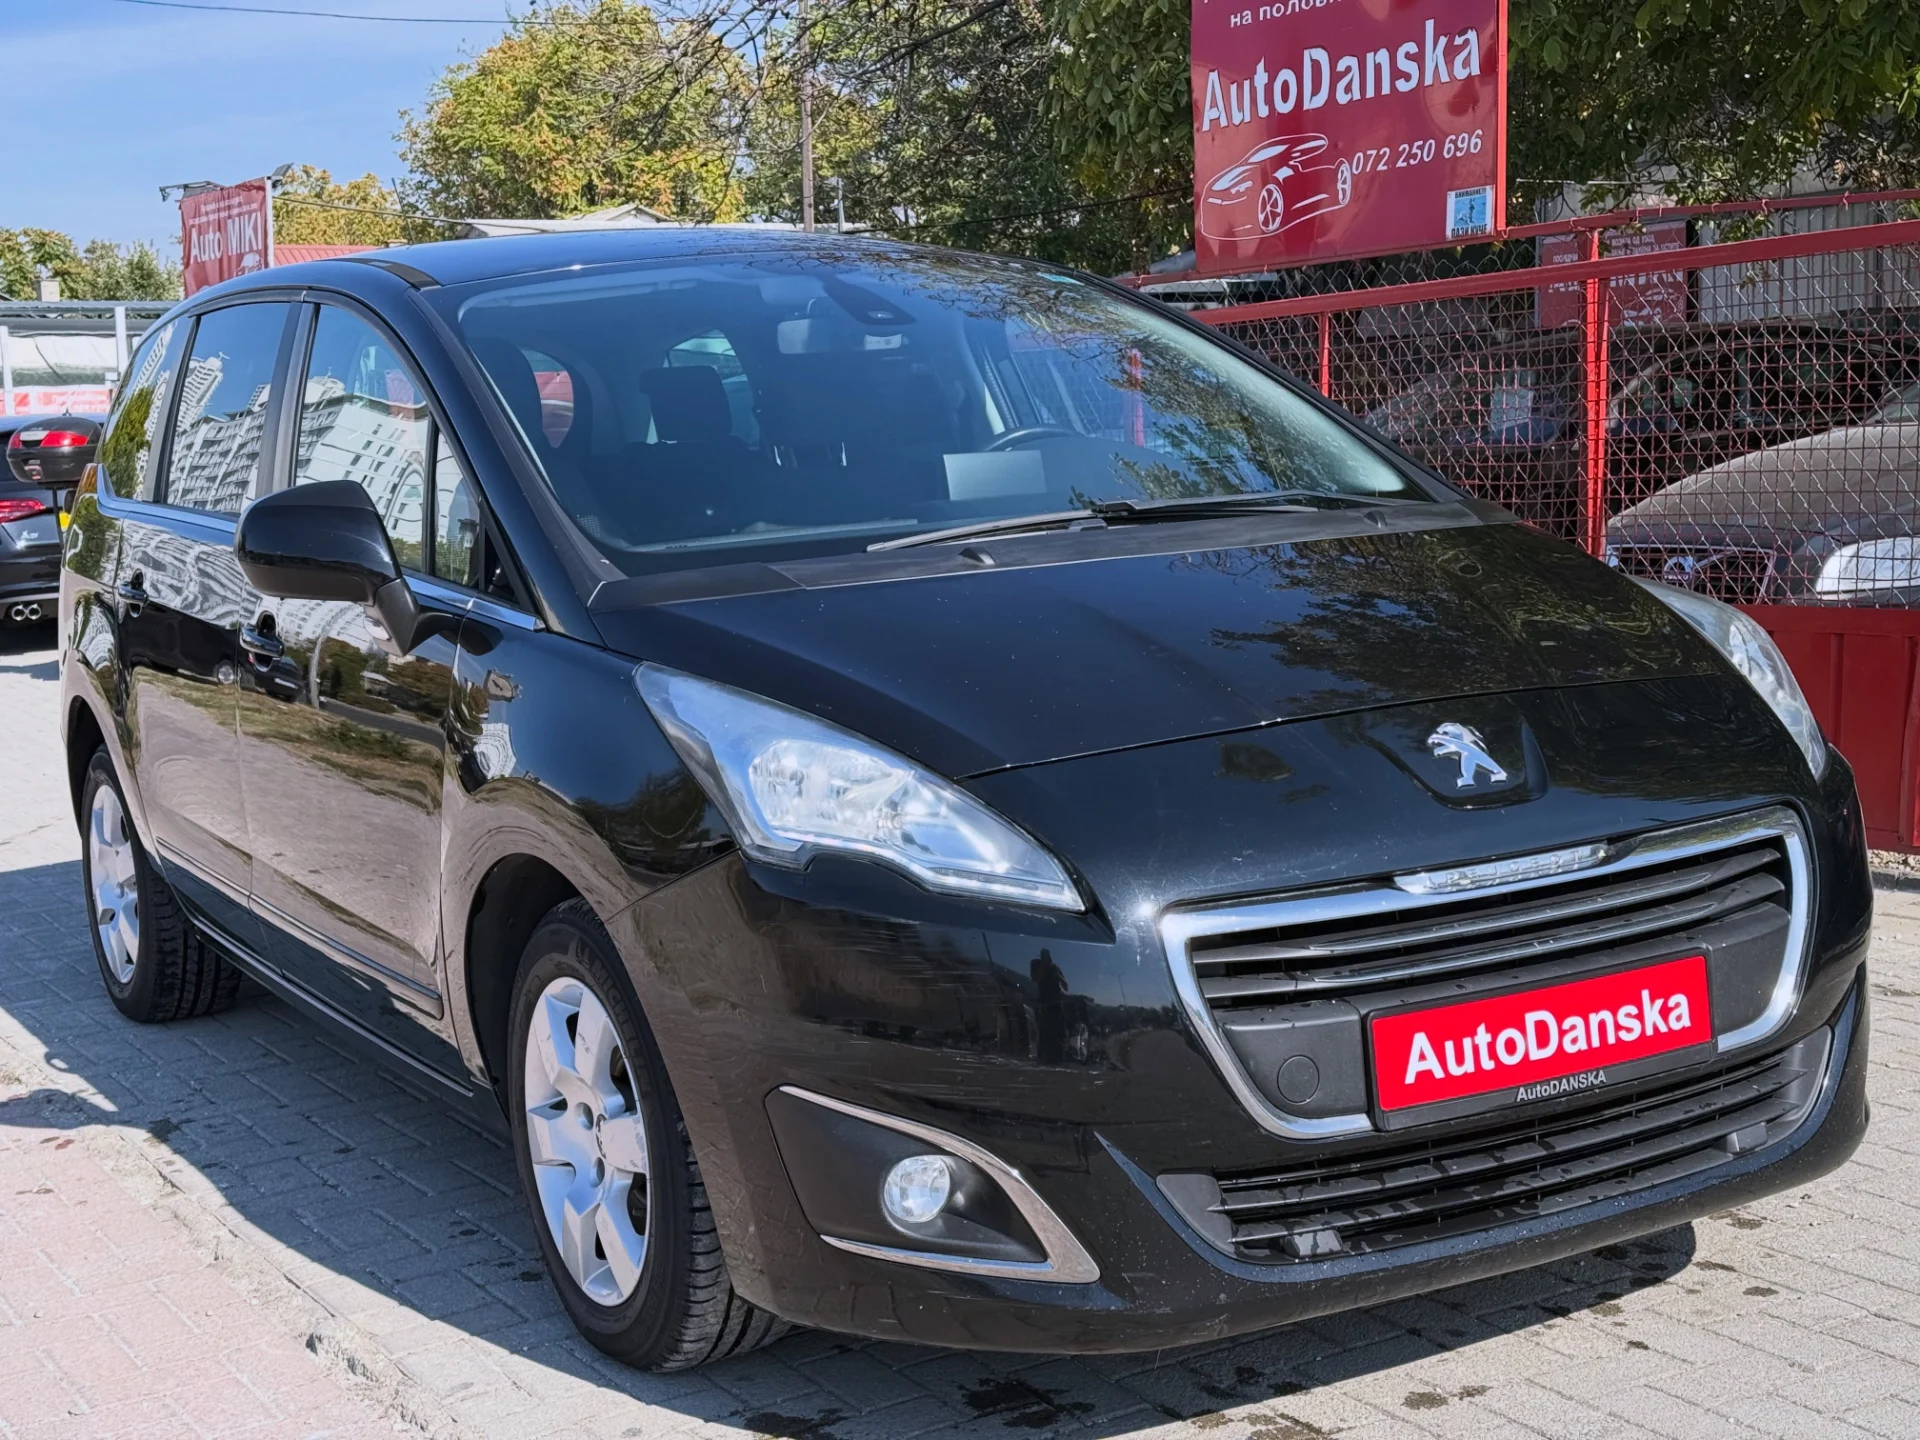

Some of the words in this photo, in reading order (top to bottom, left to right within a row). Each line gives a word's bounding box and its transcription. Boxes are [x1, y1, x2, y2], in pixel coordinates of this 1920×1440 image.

[1230, 10, 1252, 28] на
[1259, 0, 1341, 21] полов
[1202, 18, 1481, 132] AutoDanska
[1352, 147, 1391, 175] 072
[1396, 139, 1436, 168] 250
[1443, 129, 1483, 159] 696
[190, 224, 223, 265] Auto
[227, 211, 262, 256] MIKI
[1404, 988, 1692, 1085] AutoDanska
[1516, 1069, 1607, 1102] AutoDANSKA
